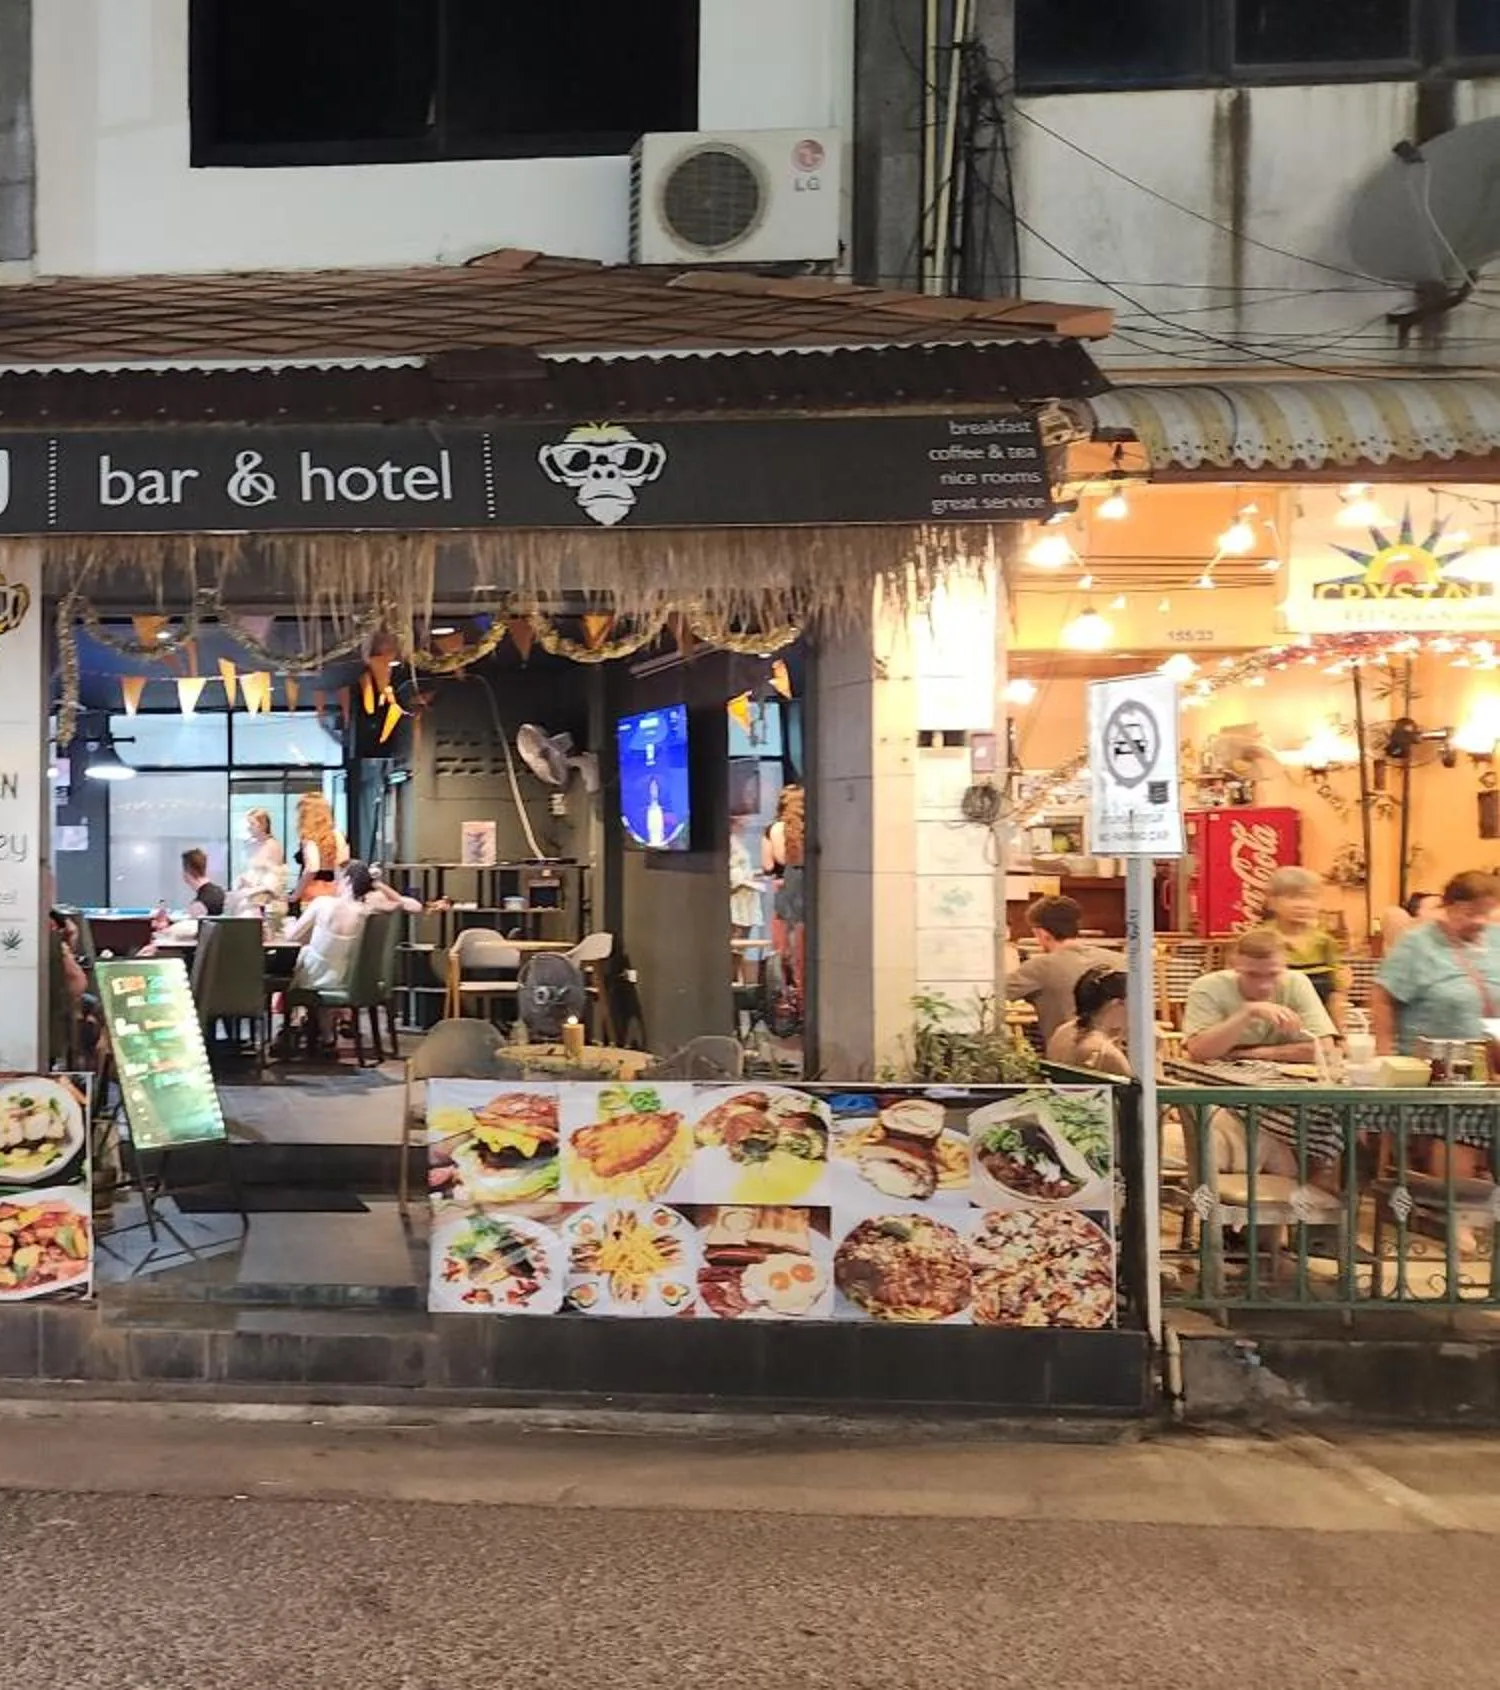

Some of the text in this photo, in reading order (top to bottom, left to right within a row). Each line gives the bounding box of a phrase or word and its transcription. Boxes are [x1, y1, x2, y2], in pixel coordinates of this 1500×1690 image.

[794, 176, 821, 192] LG
[948, 418, 1033, 434] breakfast
[928, 444, 1037, 460] coffee & tea
[100, 449, 453, 507] bar & hotel
[940, 470, 1043, 485] nice rooms
[931, 495, 1045, 515] great service
[1231, 820, 1278, 935] ca-Cola
